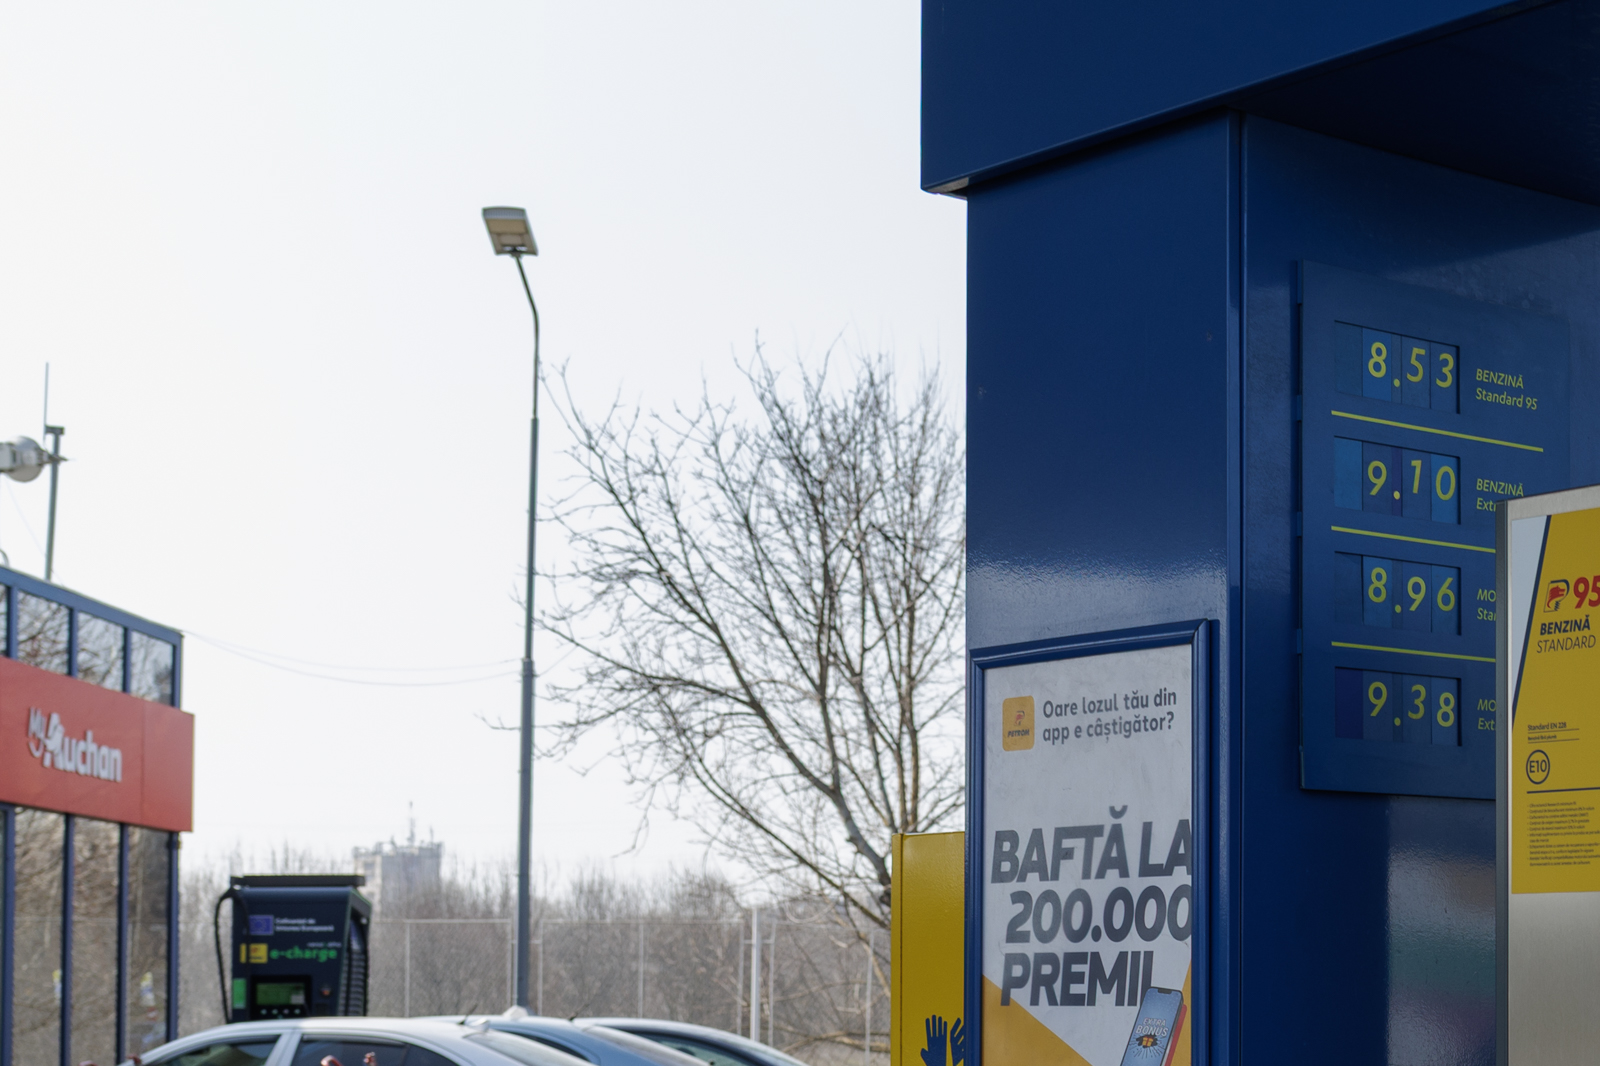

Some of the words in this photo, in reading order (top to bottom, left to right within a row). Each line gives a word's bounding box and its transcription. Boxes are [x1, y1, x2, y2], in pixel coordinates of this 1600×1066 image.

[1368, 342, 1454, 388] 8.53
[1476, 368, 1524, 389] BENZINĂ
[1476, 388, 1524, 408] Standard
[1526, 397, 1538, 410] 95
[1368, 460, 1456, 500] 9.10
[1476, 478, 1524, 497] BENZINĂ
[1368, 567, 1455, 613] 8.96
[1540, 614, 1590, 636] BENZINĂ
[1537, 634, 1596, 653] STANDARD
[1043, 700, 1078, 718] Oare
[1082, 693, 1118, 714] lozul
[1124, 690, 1149, 710] tău
[1154, 687, 1177, 707] din
[1368, 681, 1455, 727] 9.38
[1008, 729, 1030, 738] PETROM
[1043, 727, 1070, 745] app
[1074, 725, 1082, 738] e
[1086, 711, 1174, 744] câștigător?
[42, 712, 122, 783] Auchan
[1529, 759, 1548, 774] E10
[991, 805, 1130, 884] BAFTĂ
[1138, 819, 1192, 878] LA
[1006, 884, 1192, 944] 200.000
[1136, 1025, 1168, 1036] BONUS
[1144, 1018, 1166, 1026] EXTRA
